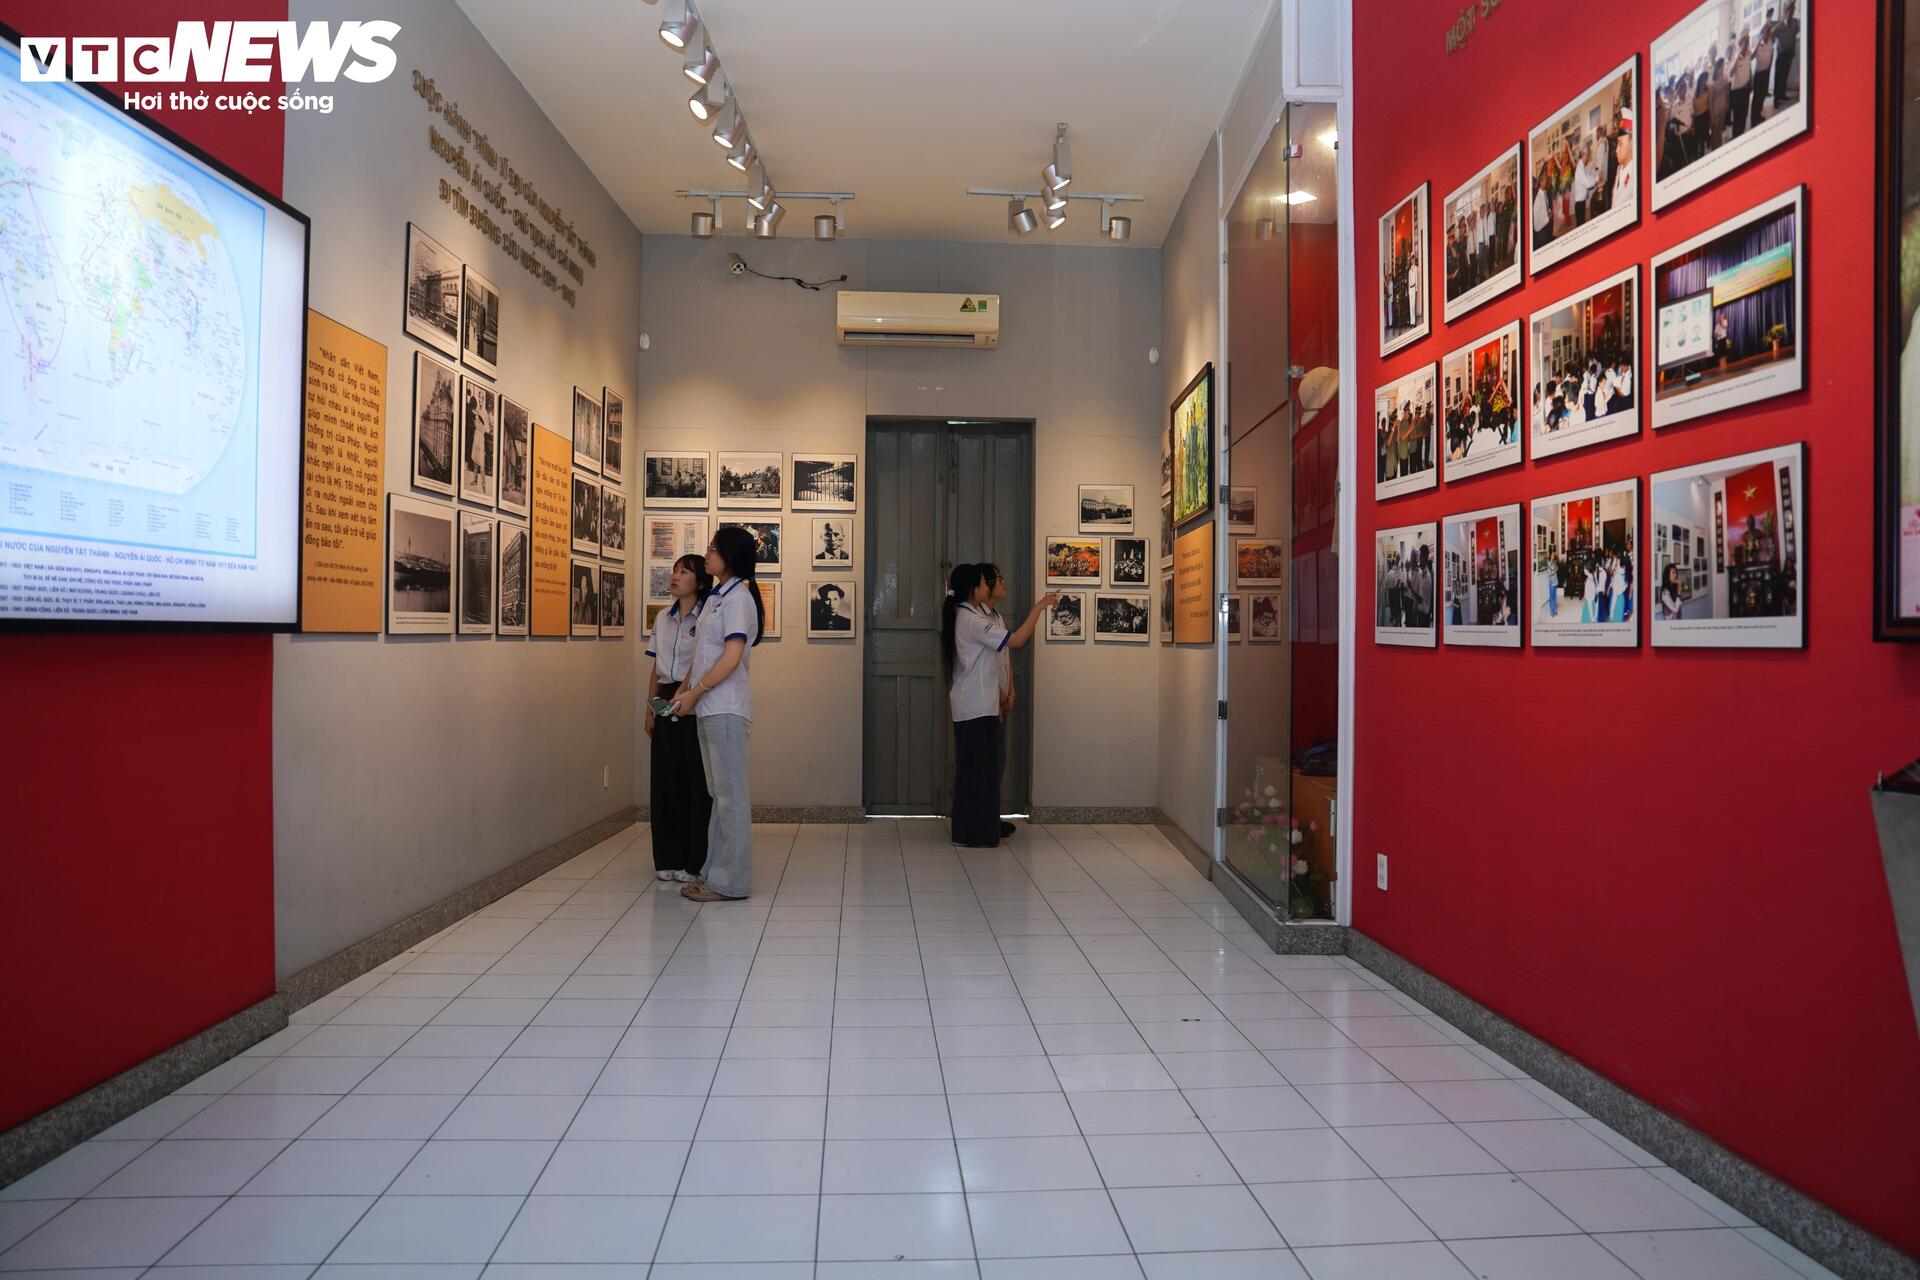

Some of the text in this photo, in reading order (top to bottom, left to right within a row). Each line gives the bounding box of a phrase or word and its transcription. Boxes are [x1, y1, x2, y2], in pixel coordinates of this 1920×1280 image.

[412, 70, 442, 112] CUỘC
[444, 101, 471, 143] HÀNH
[429, 125, 470, 180] NGUYỄN
[483, 180, 506, 214] QUỐC
[439, 178, 450, 203] ĐI
[308, 359, 324, 375] trong
[327, 367, 334, 377] đó
[337, 371, 344, 381] có
[347, 374, 357, 389] ông
[308, 376, 320, 387] sinh
[321, 382, 328, 390] ra
[314, 473, 325, 484] cho
